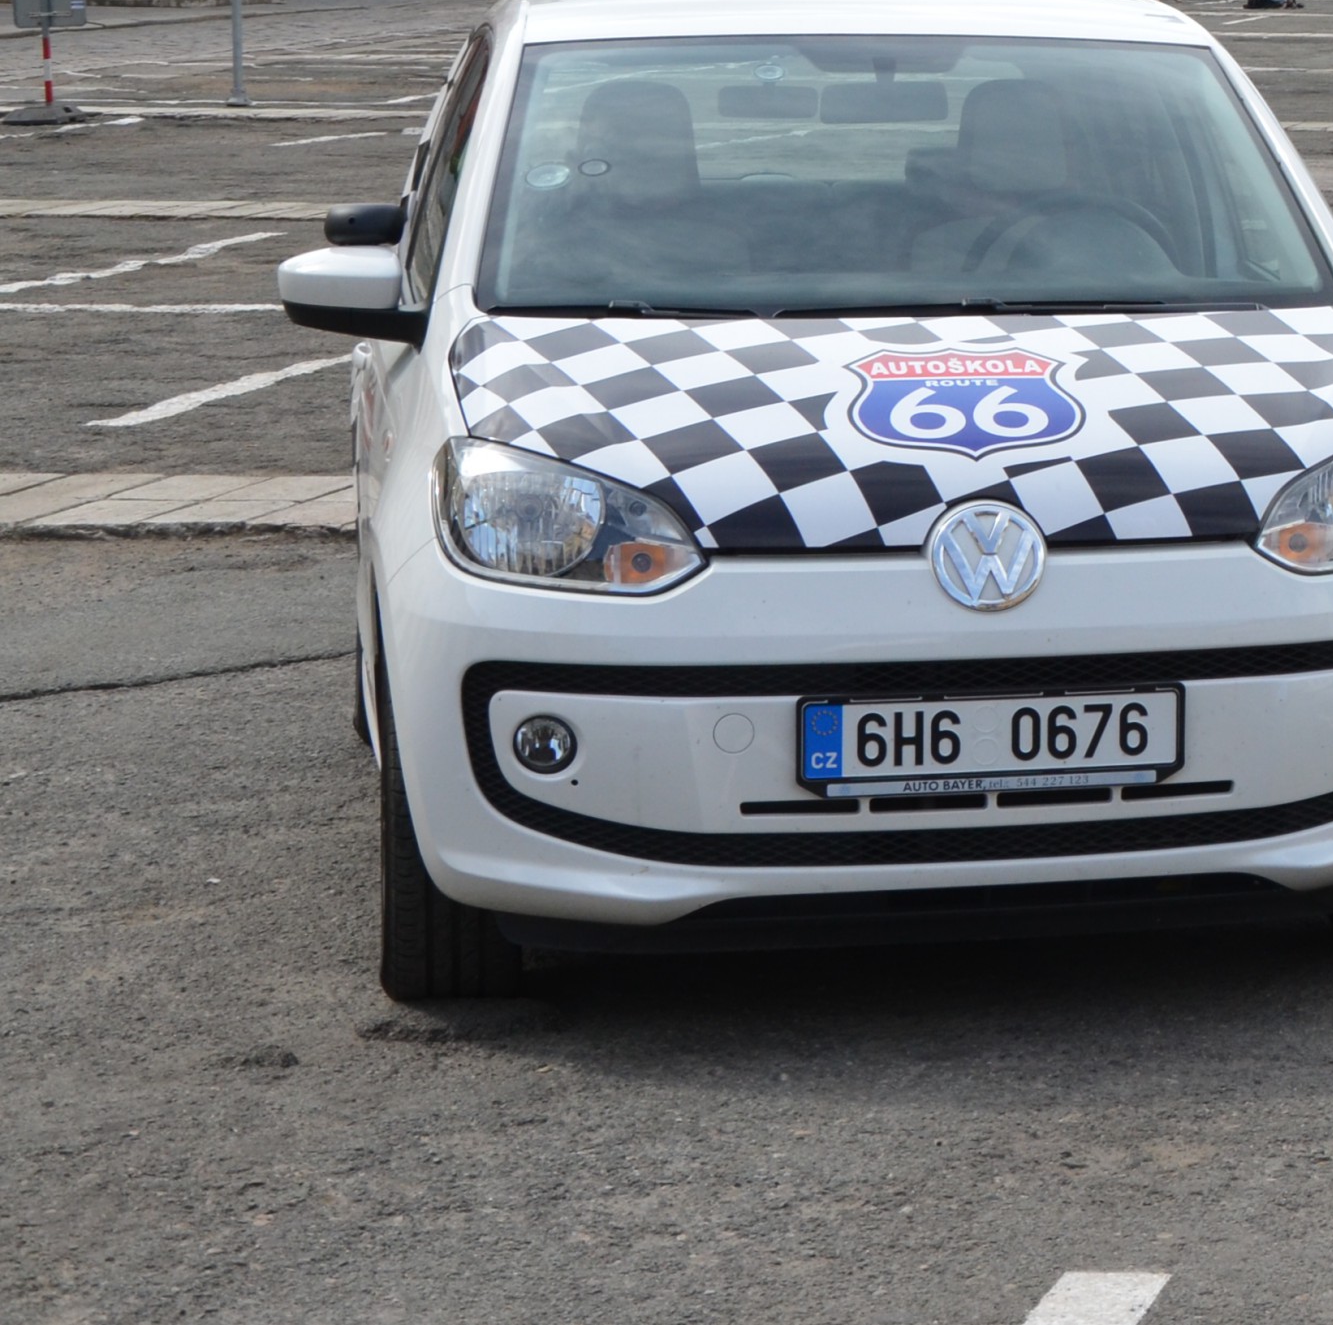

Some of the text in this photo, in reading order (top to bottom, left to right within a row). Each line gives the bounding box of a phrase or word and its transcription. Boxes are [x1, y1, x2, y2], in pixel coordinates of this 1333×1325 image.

[870, 357, 1043, 375] AUTOŠKOLA
[924, 378, 999, 387] ROUTE
[889, 385, 1049, 439] 66
[856, 702, 1148, 767] 6H6 0676
[811, 751, 838, 769] CZ
[902, 780, 939, 792] AUTO
[942, 778, 987, 791] BAYER,
[1016, 777, 1039, 788] 544
[1042, 775, 1064, 786] 227
[1068, 774, 1090, 785] 123
